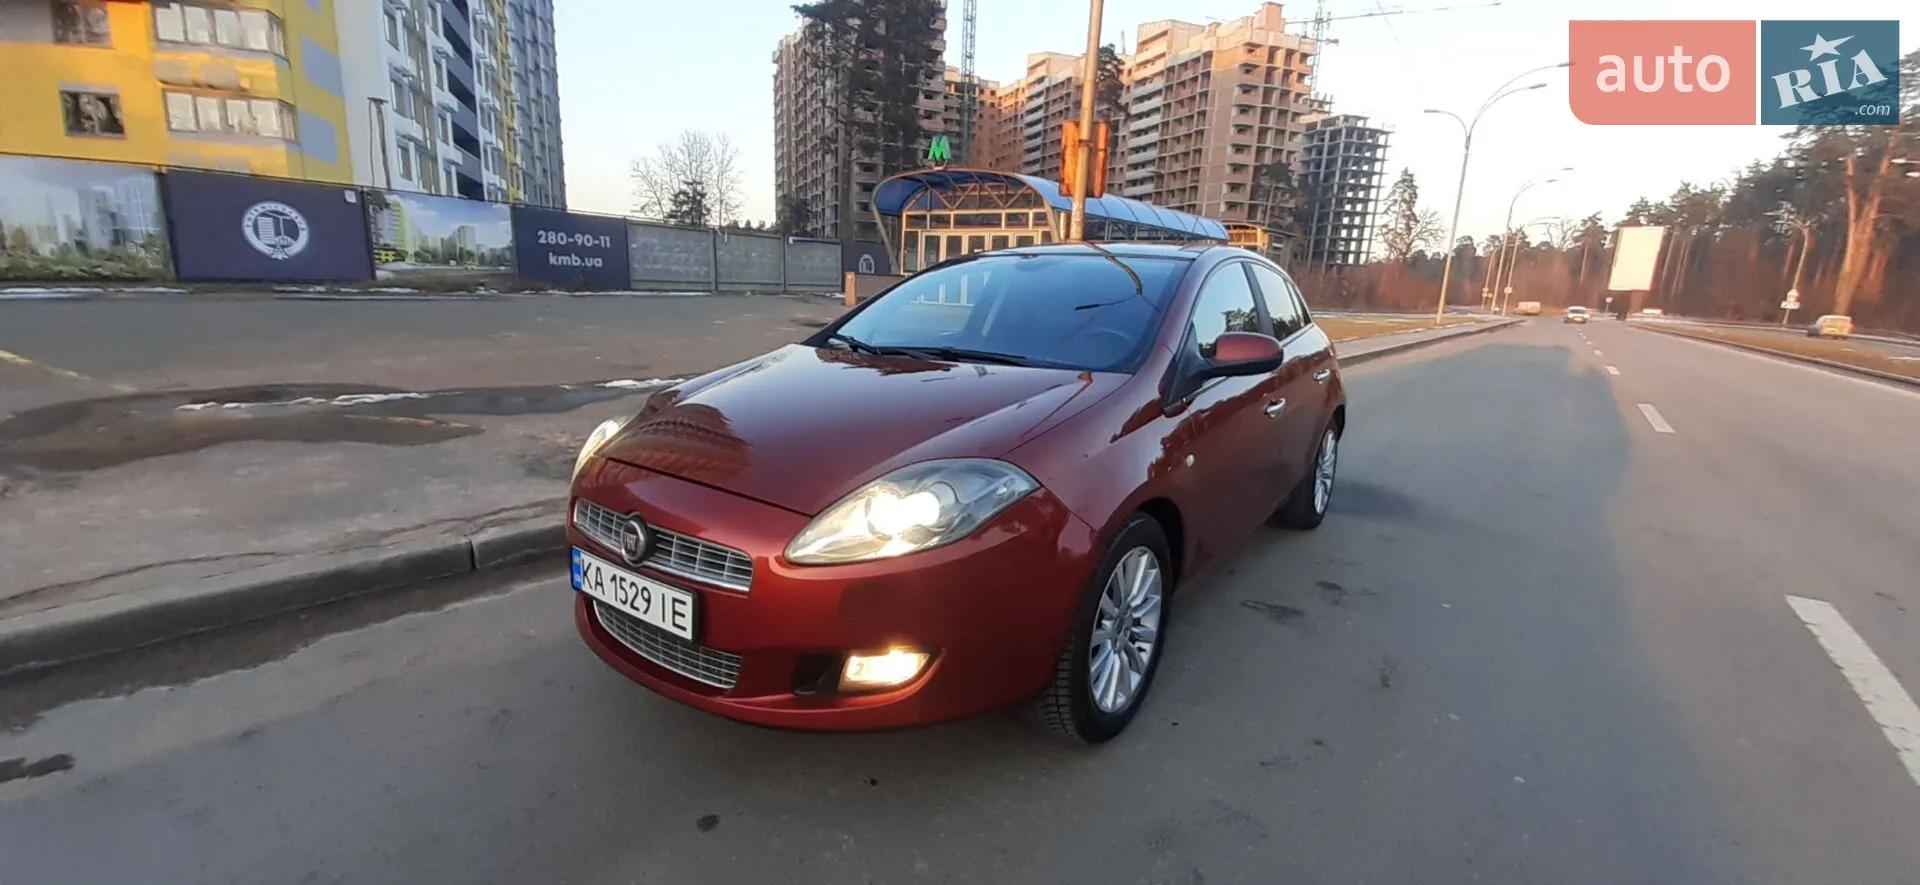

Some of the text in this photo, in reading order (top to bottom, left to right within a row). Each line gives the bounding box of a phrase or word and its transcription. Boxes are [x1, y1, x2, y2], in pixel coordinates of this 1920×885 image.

[537, 230, 611, 249] 280-90-11
[548, 251, 603, 268] kmb.ua
[581, 558, 605, 595] KA
[610, 573, 652, 615] 1529
[661, 592, 687, 632] IE
